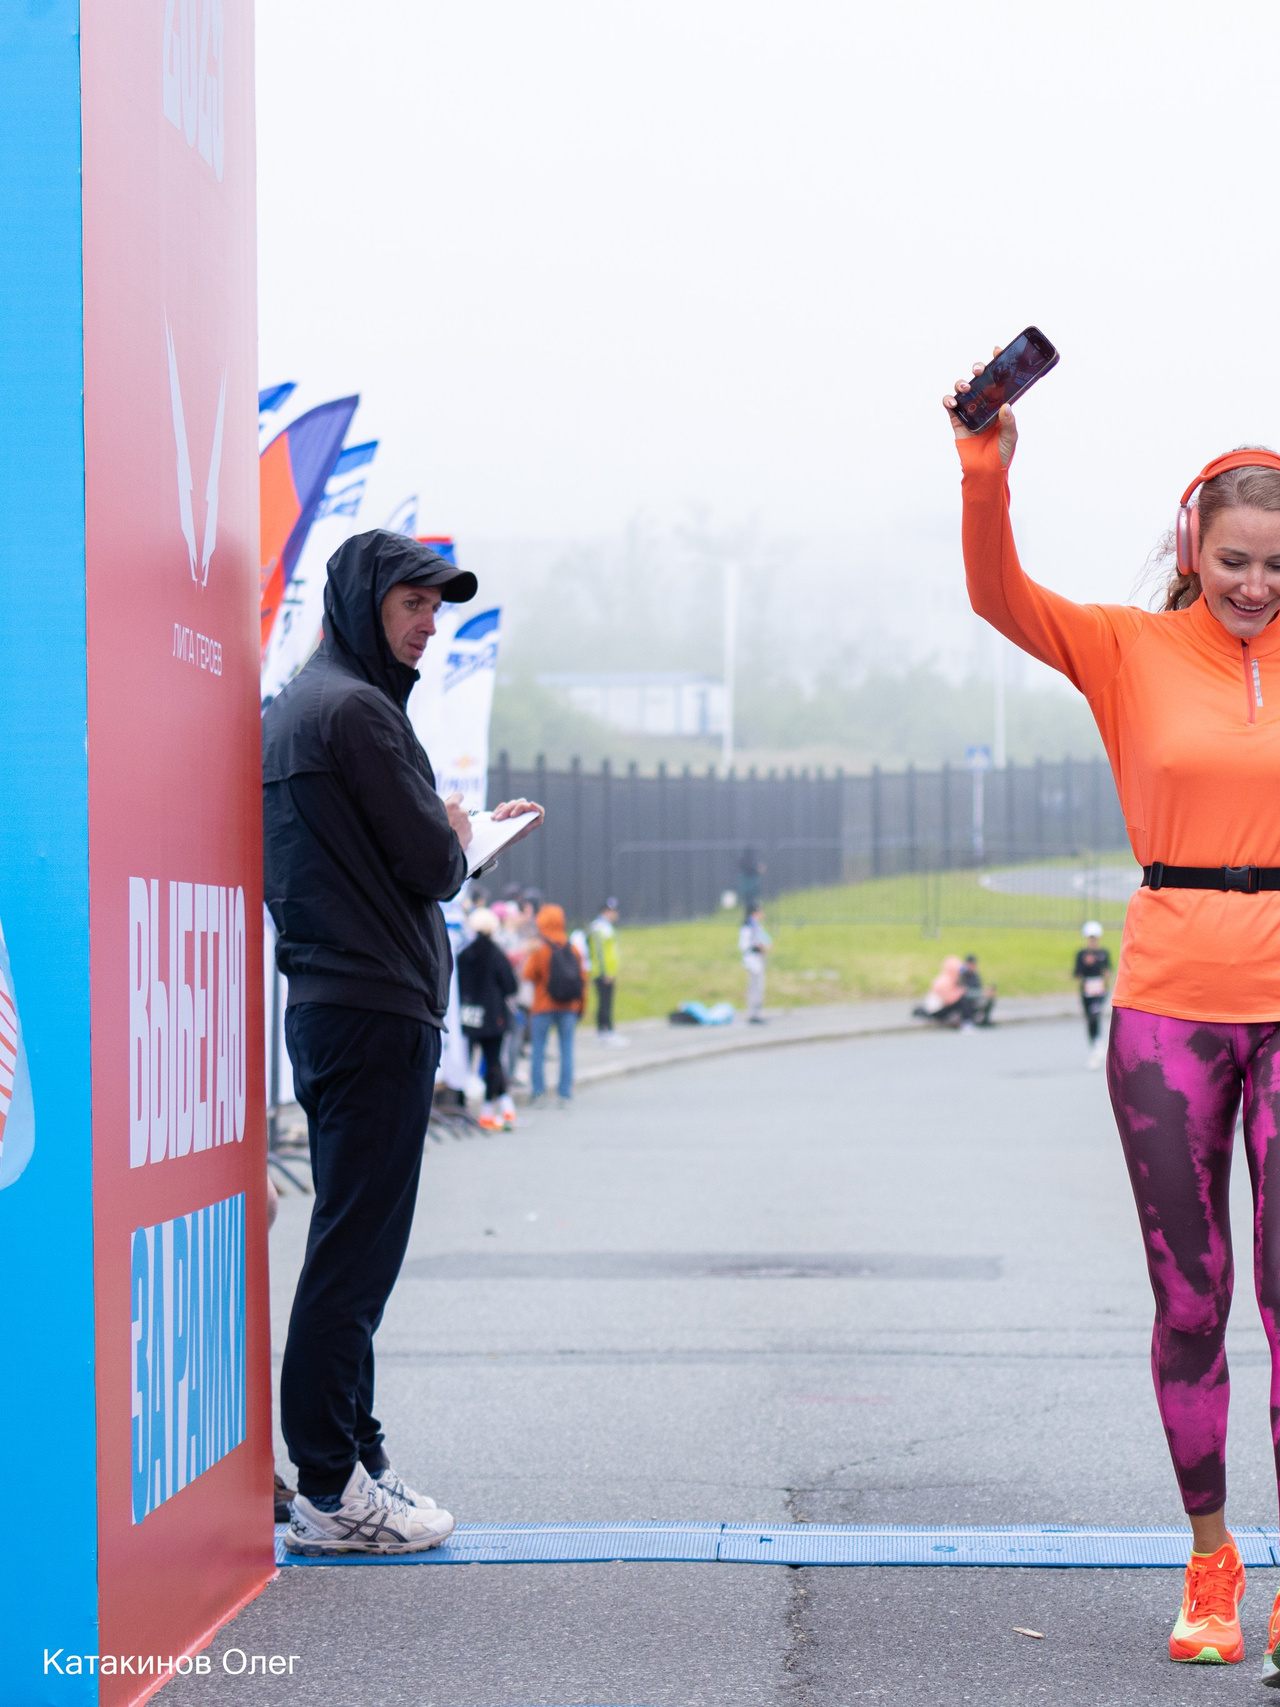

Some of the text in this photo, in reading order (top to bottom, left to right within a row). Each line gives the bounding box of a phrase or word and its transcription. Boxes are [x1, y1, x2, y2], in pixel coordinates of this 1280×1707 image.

[172, 622, 223, 677] ЛИГА ГЕРОЕВ
[129, 876, 246, 1169] ВЫБЕГАНО
[131, 1191, 246, 1525] ЗА РАМКИ
